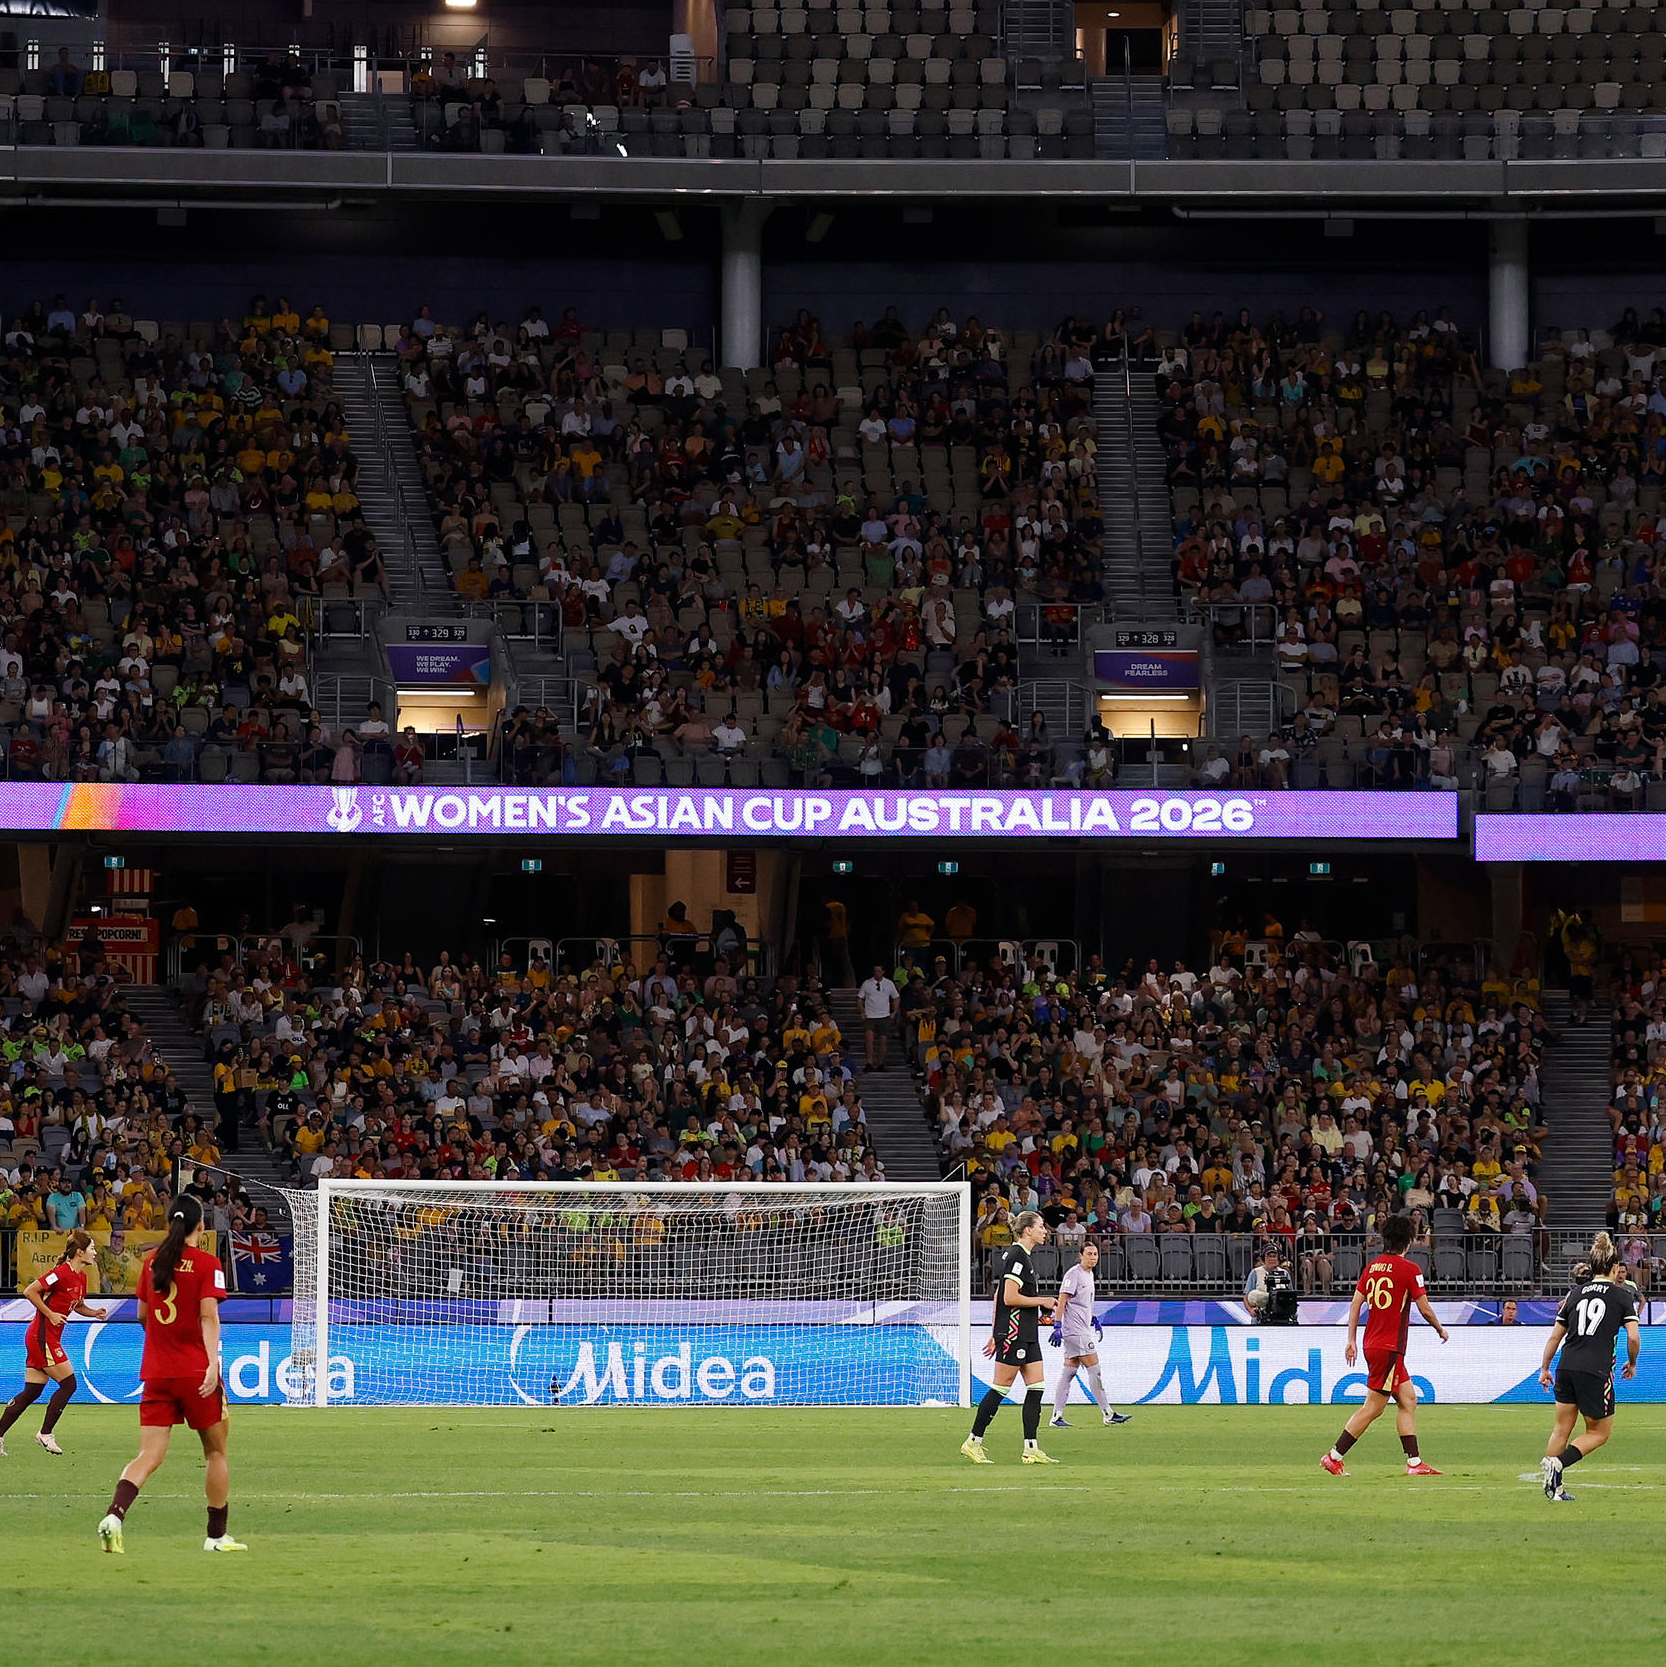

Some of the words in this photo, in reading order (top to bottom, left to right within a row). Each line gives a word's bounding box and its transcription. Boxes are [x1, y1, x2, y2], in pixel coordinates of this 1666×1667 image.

[432, 628, 449, 638] 329
[1141, 634, 1159, 643] 328
[372, 793, 385, 826] AFC
[390, 794, 591, 829] WOMEN'S
[600, 796, 733, 830] ASIAN
[742, 797, 833, 831] CUP
[838, 797, 1121, 831] AUSTRALIA
[23, 1232, 50, 1243] R.I.P
[154, 1281, 178, 1324] 3
[1366, 1277, 1393, 1310] 26
[1581, 1284, 1610, 1294] GORRY
[1576, 1298, 1606, 1336] 19
[557, 1342, 775, 1402] Midea
